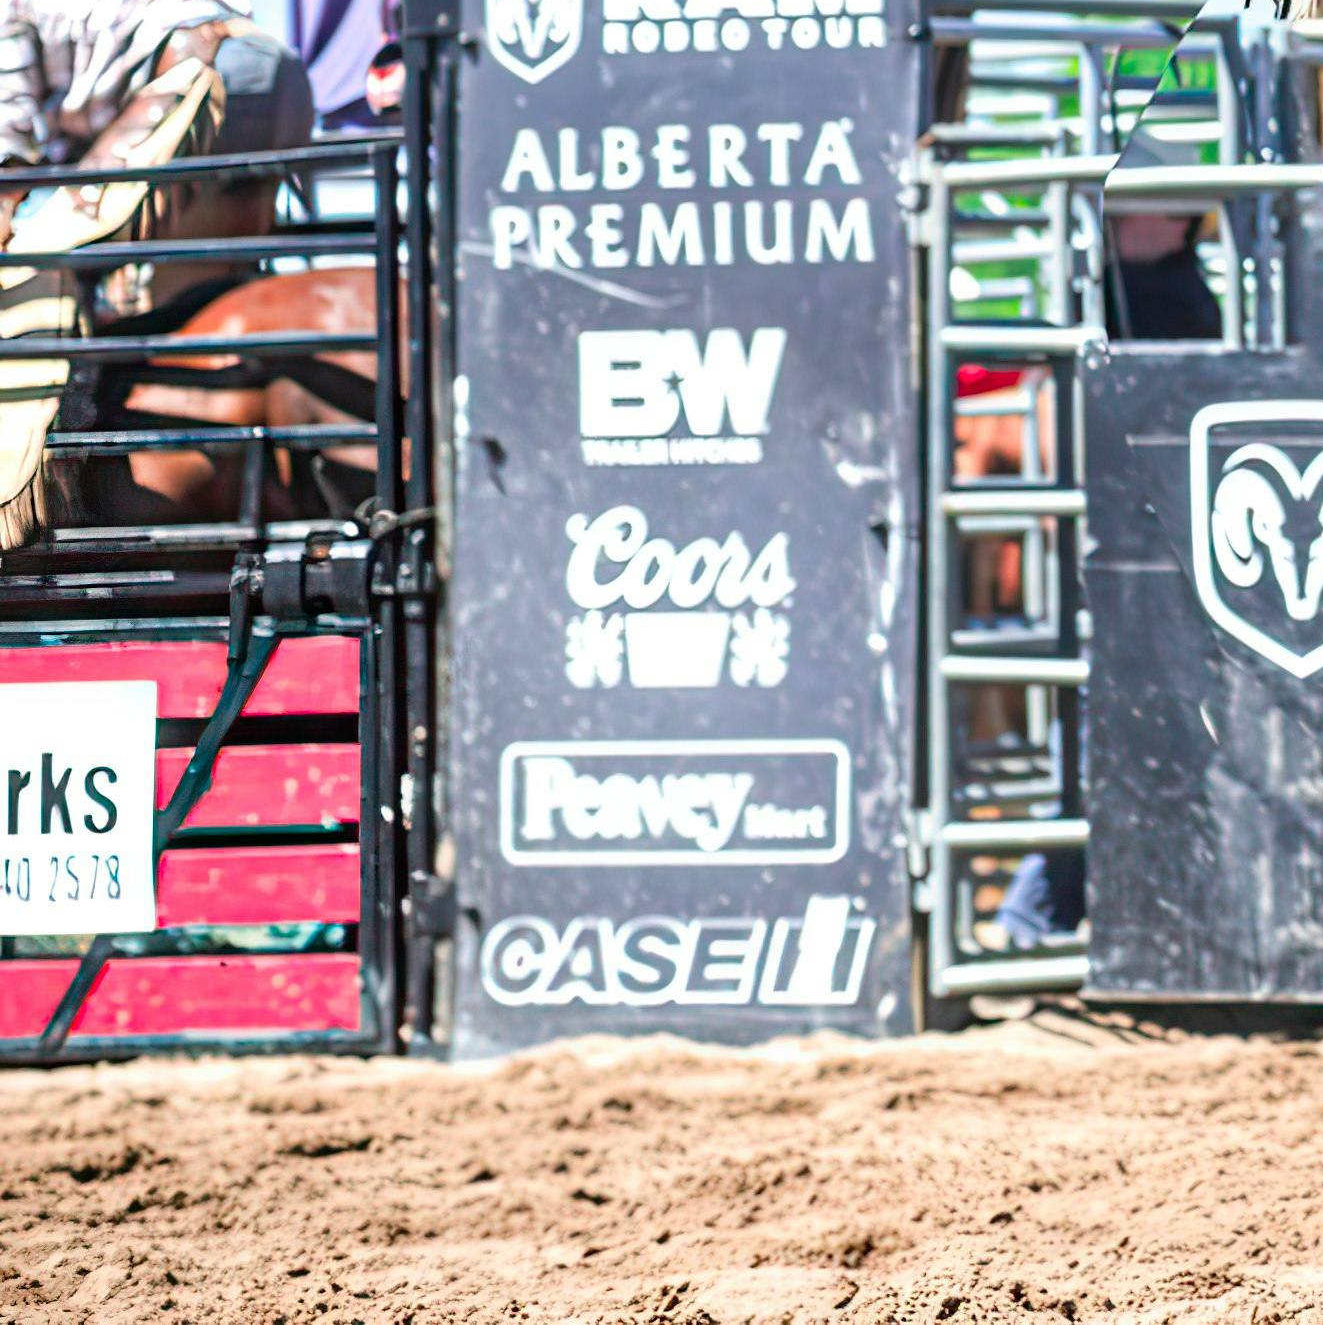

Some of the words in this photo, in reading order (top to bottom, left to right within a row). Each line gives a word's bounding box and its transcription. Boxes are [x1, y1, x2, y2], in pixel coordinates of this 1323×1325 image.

[603, 18, 751, 54] RODEO
[762, 17, 887, 50] TOUR
[501, 120, 863, 192] ALBERTA
[490, 198, 875, 269] PREMIUM
[578, 327, 787, 436] BW
[565, 504, 796, 609] Coors
[521, 756, 754, 852] Peavey
[744, 803, 827, 839] Mart
